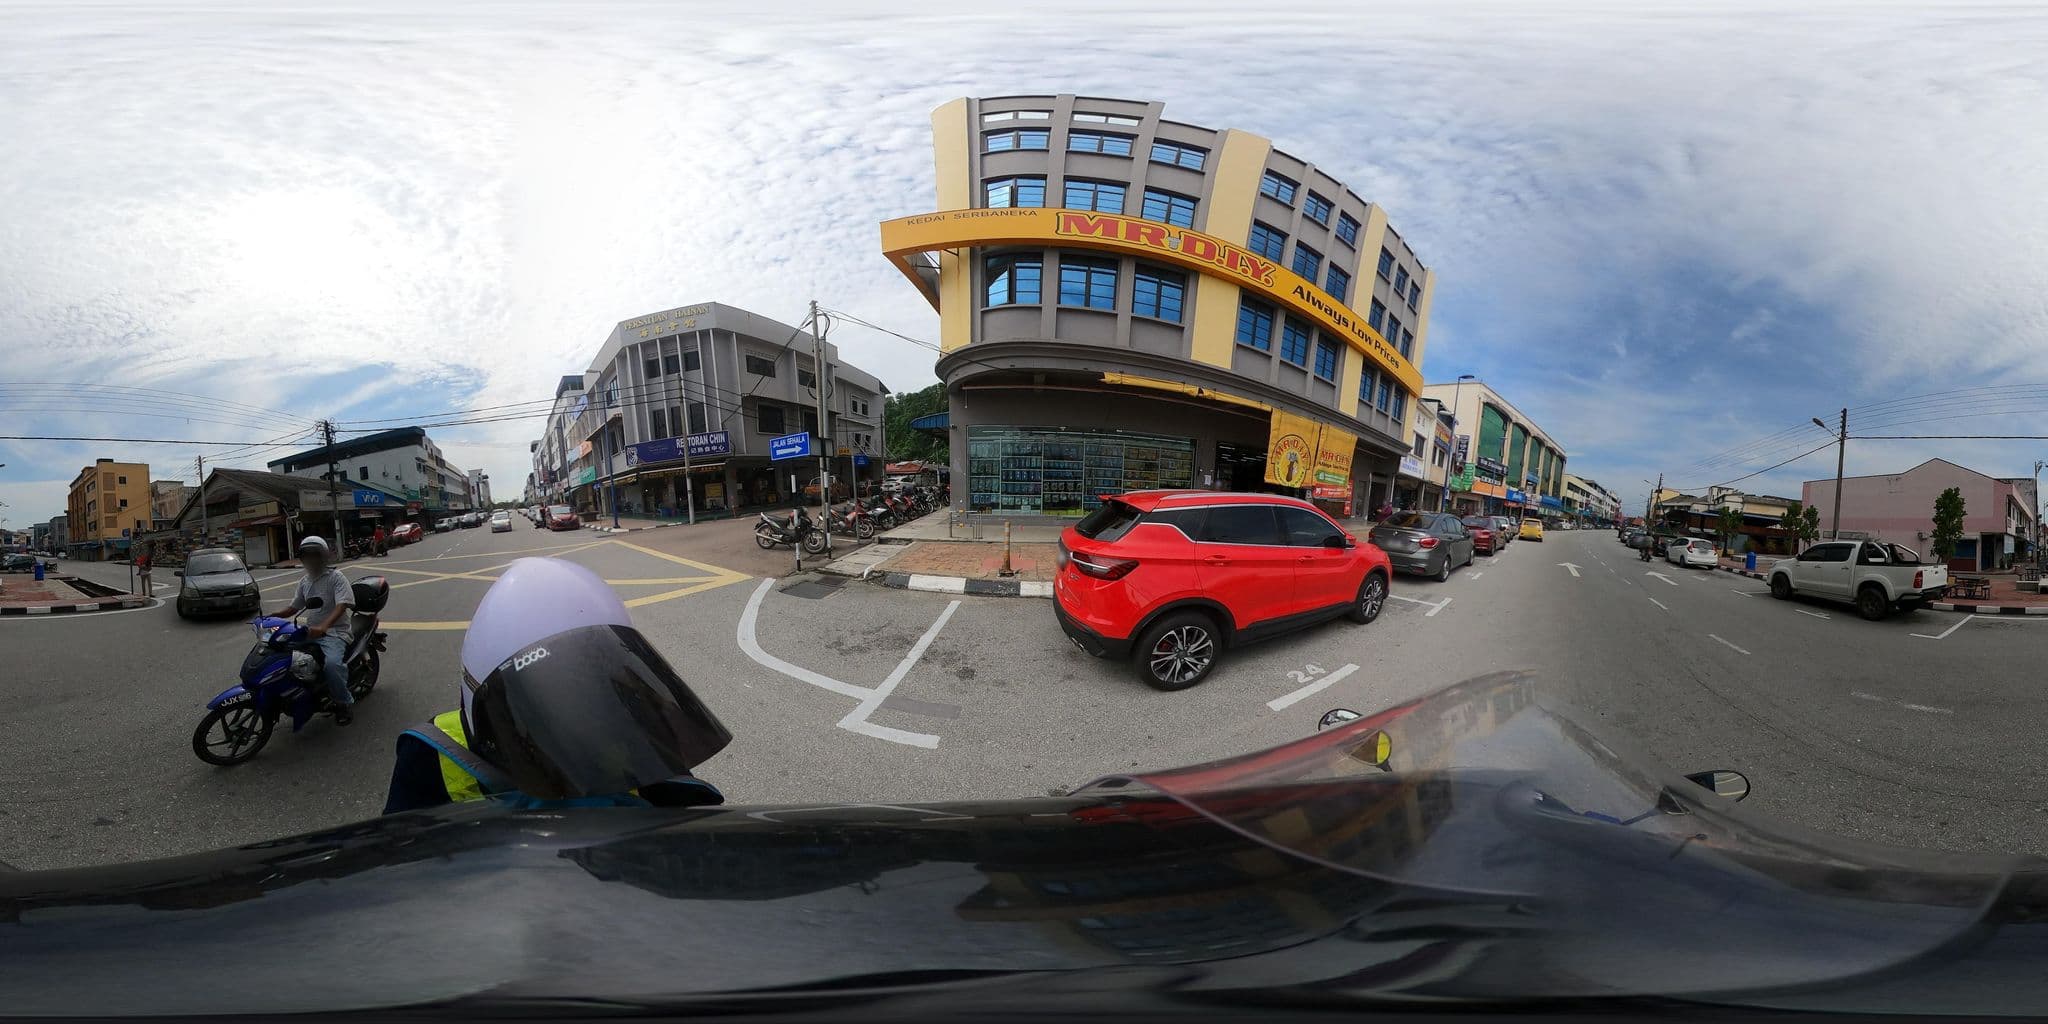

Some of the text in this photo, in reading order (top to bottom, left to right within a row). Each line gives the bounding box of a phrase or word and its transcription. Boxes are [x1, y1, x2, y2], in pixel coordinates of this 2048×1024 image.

[907, 209, 1038, 226] KEDAI SERBANEKA
[1061, 213, 1169, 248] MR
[1292, 285, 1400, 369] Always Low Prices
[676, 432, 725, 449] RETORAN CHIN
[1286, 663, 1326, 683] 24
